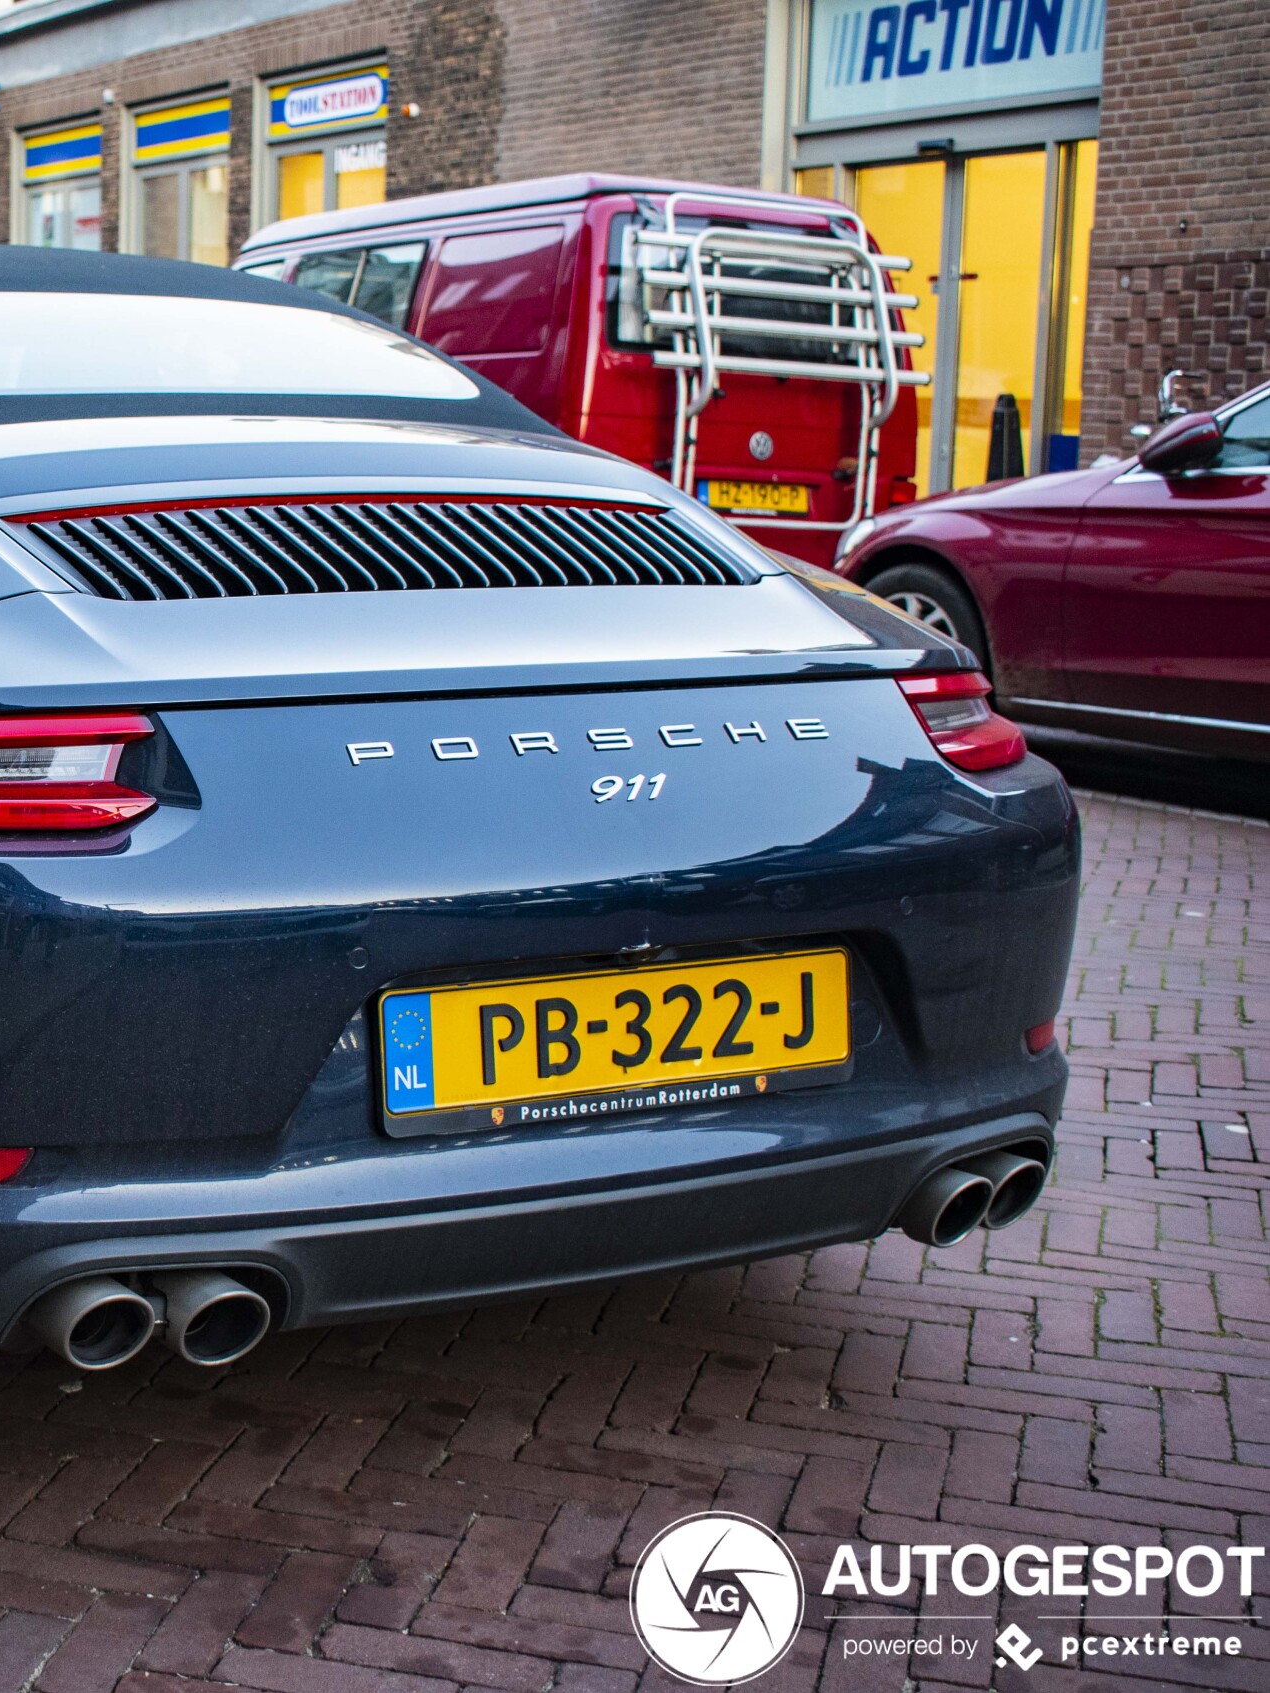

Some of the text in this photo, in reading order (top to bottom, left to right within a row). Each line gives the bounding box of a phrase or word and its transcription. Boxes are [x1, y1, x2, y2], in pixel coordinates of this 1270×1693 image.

[860, 0, 1065, 83] ACTION
[289, 86, 377, 118] TOOLSTATION
[347, 718, 830, 765] PORSCHE
[591, 772, 667, 803] 911
[478, 971, 815, 1086] PB-322-J
[394, 1065, 427, 1091] NL
